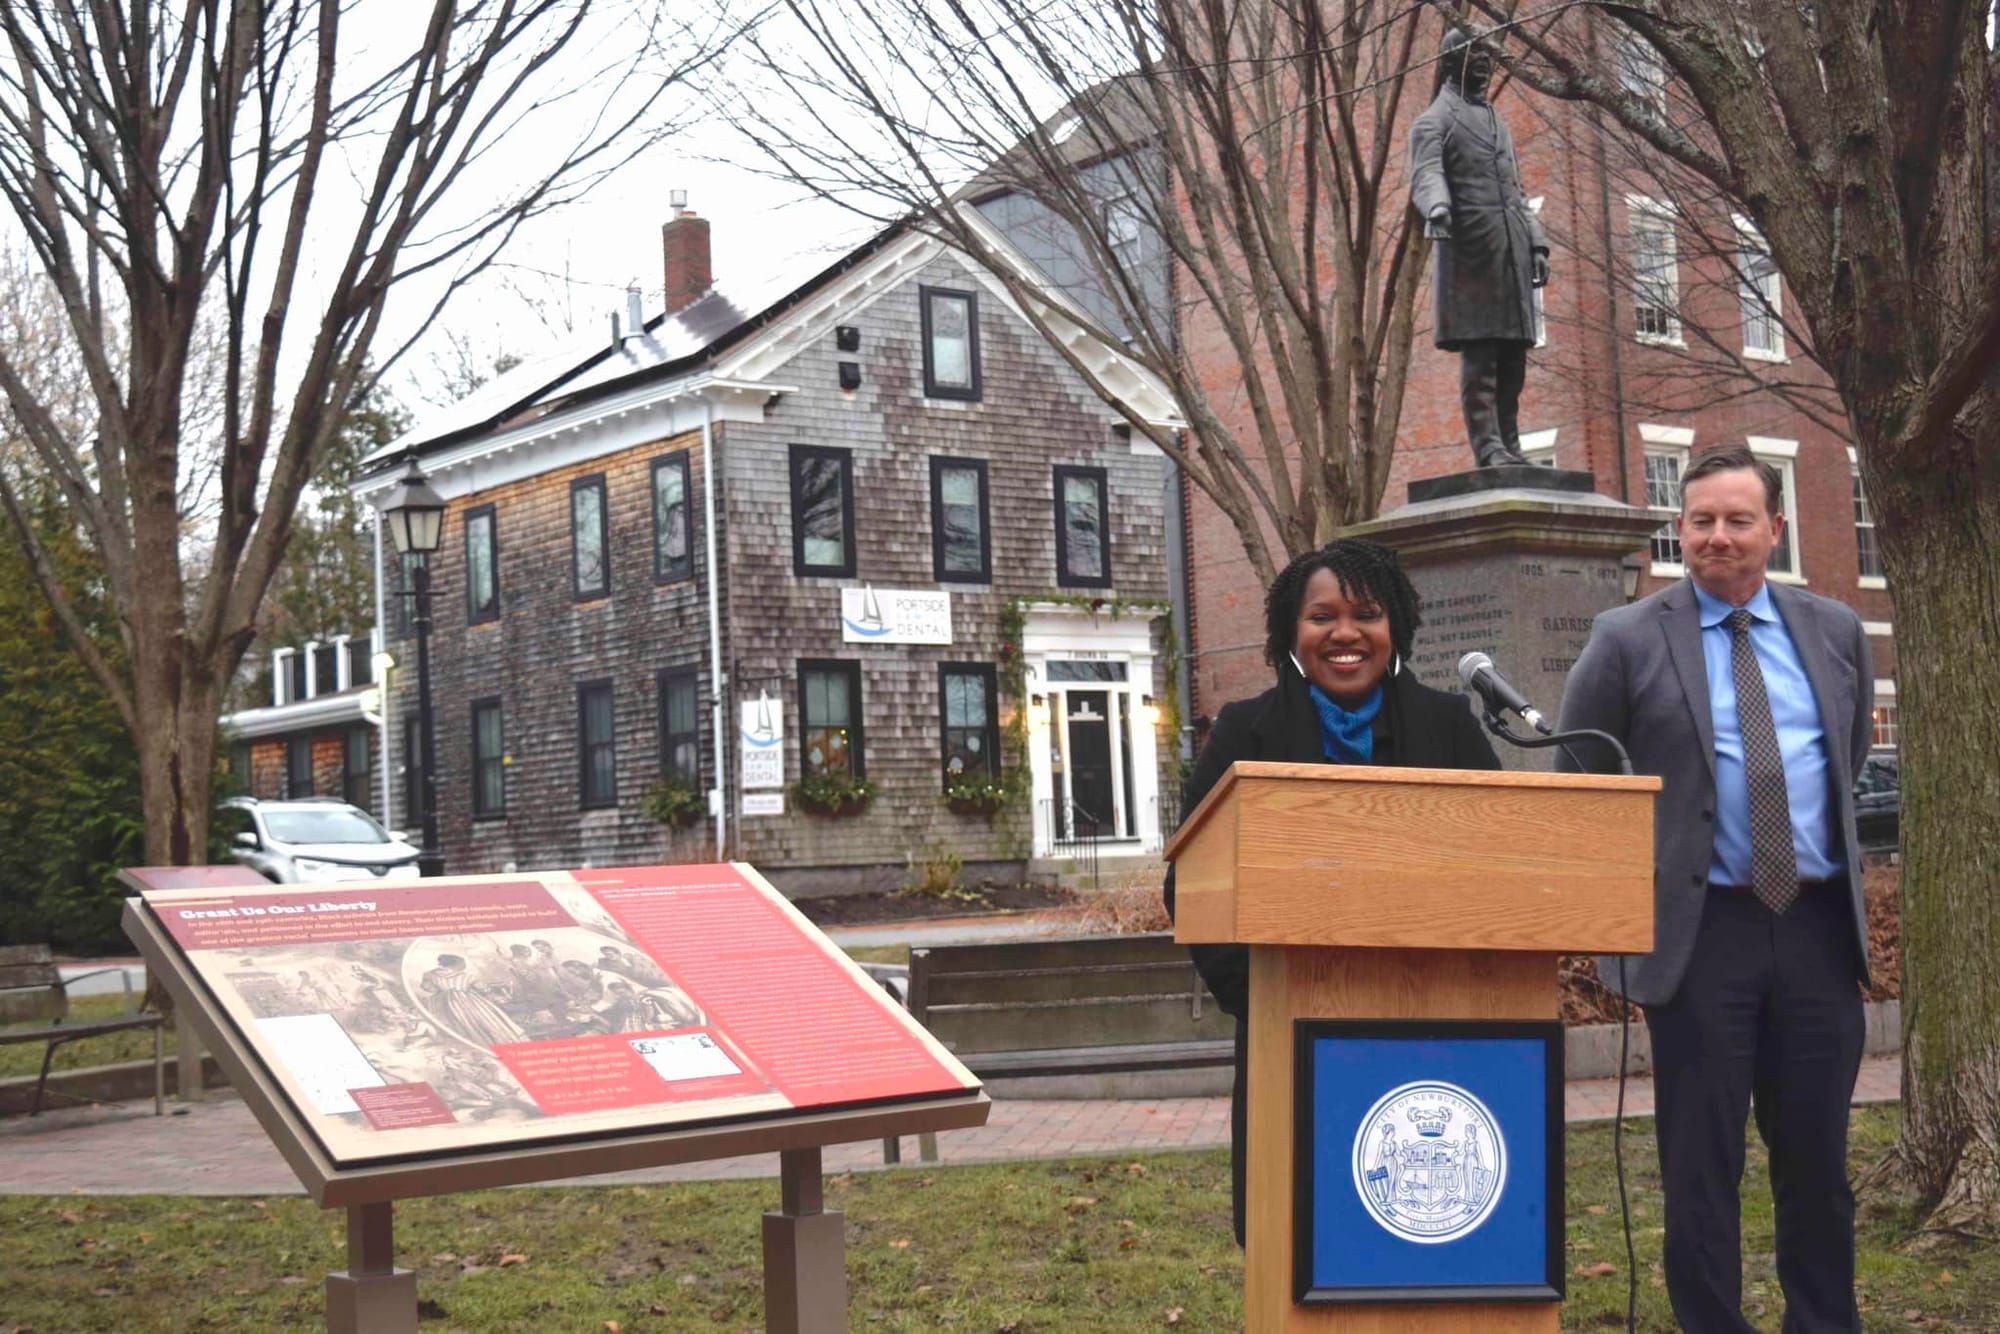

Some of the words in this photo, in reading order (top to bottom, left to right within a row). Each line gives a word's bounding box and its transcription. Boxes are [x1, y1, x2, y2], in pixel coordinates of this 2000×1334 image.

[896, 598, 946, 612] PORTSIDE
[896, 623, 948, 637] DENTAL
[179, 907, 238, 919] Grant
[240, 906, 266, 917] Us
[268, 904, 304, 915] Our
[308, 901, 377, 913] Liberty
[1376, 1107, 1397, 1129] CITY
[1398, 1097, 1410, 1109] OF
[1413, 1093, 1485, 1129] NEWBURYPORT
